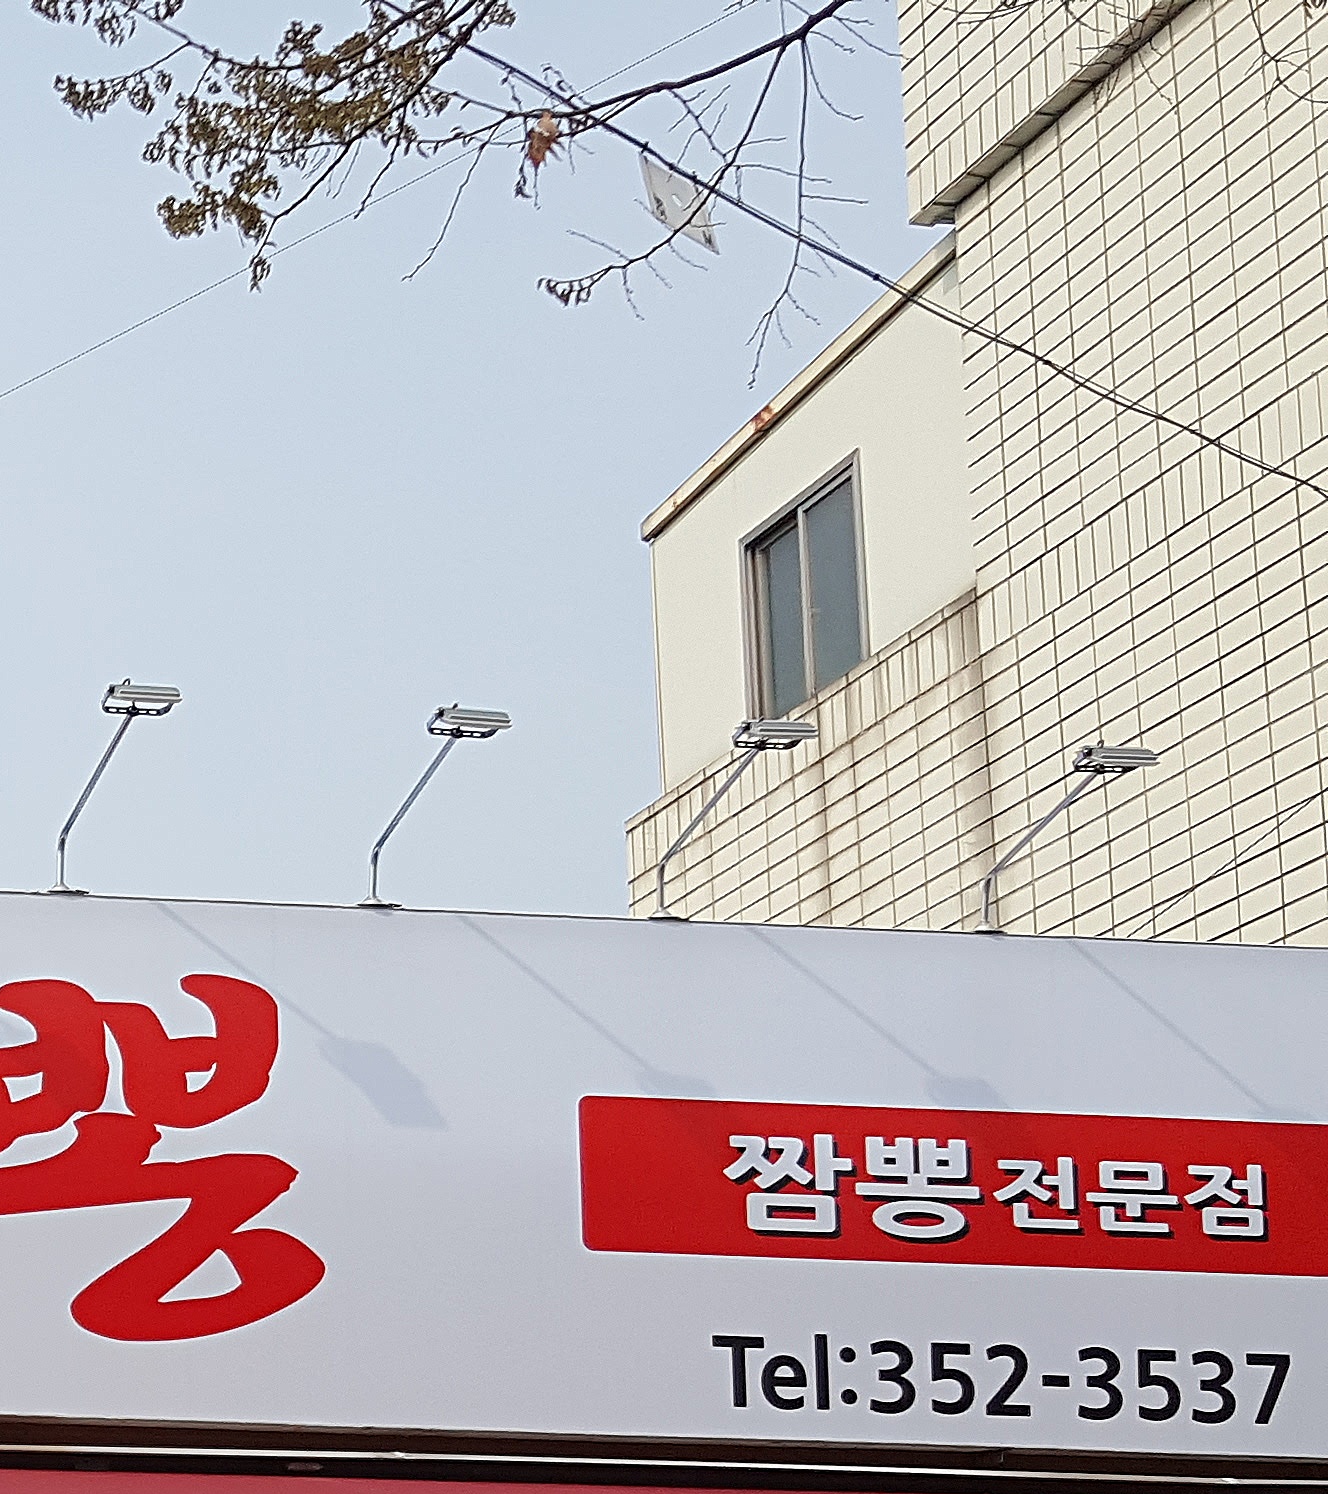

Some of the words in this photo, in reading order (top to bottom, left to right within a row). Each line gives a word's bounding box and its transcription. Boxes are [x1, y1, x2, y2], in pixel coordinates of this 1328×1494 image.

[723, 1133, 980, 1239] 짬뽕
[993, 1156, 1265, 1238] 전문점
[712, 1333, 1291, 1425] Tel:352-3537
